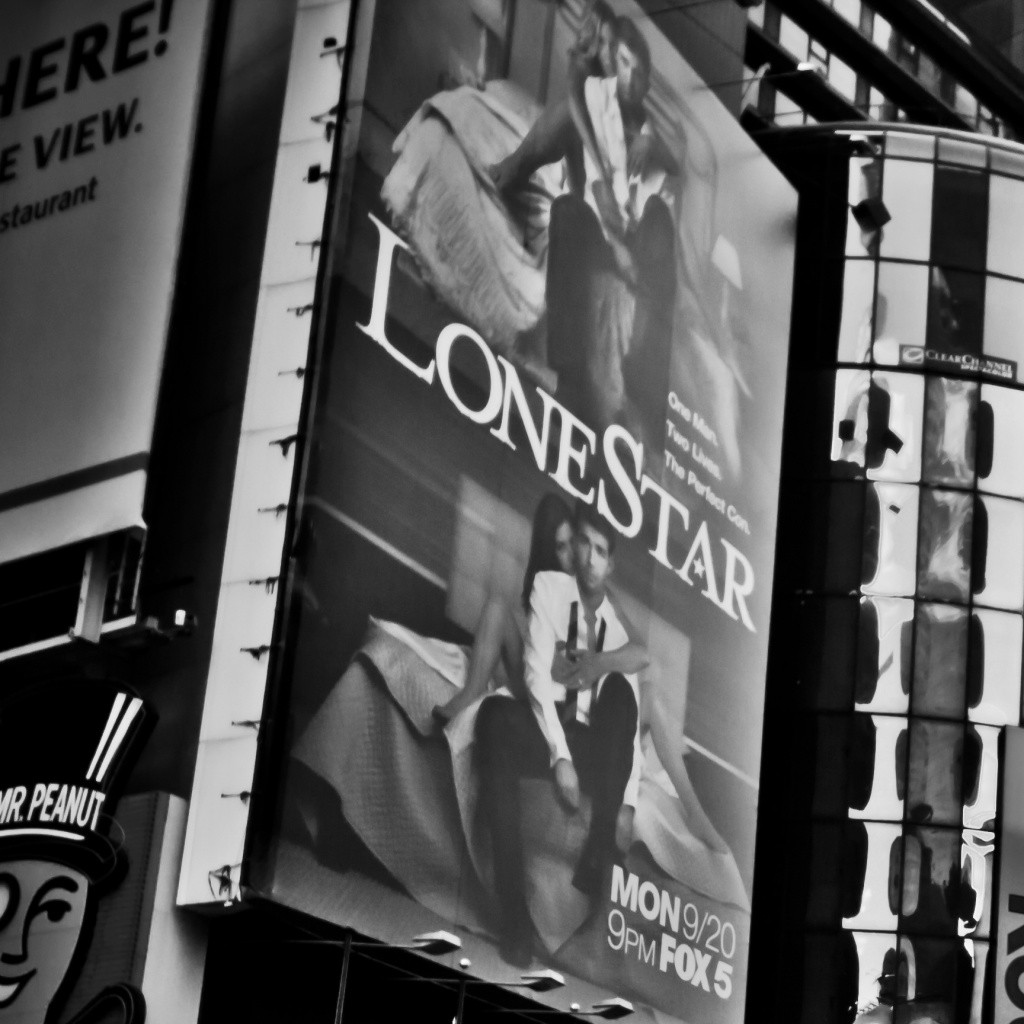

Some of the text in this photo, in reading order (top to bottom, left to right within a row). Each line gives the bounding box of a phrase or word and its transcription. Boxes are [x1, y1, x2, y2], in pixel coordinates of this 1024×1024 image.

[34, 97, 143, 170] VIEW.
[666, 418, 689, 452] Two
[668, 391, 691, 422] One
[665, 449, 685, 480] The
[688, 470, 725, 514] Perfect
[27, 783, 106, 831] PEANUT
[611, 864, 736, 958] MON 9/20
[607, 909, 734, 999] 9PM FOX 5
